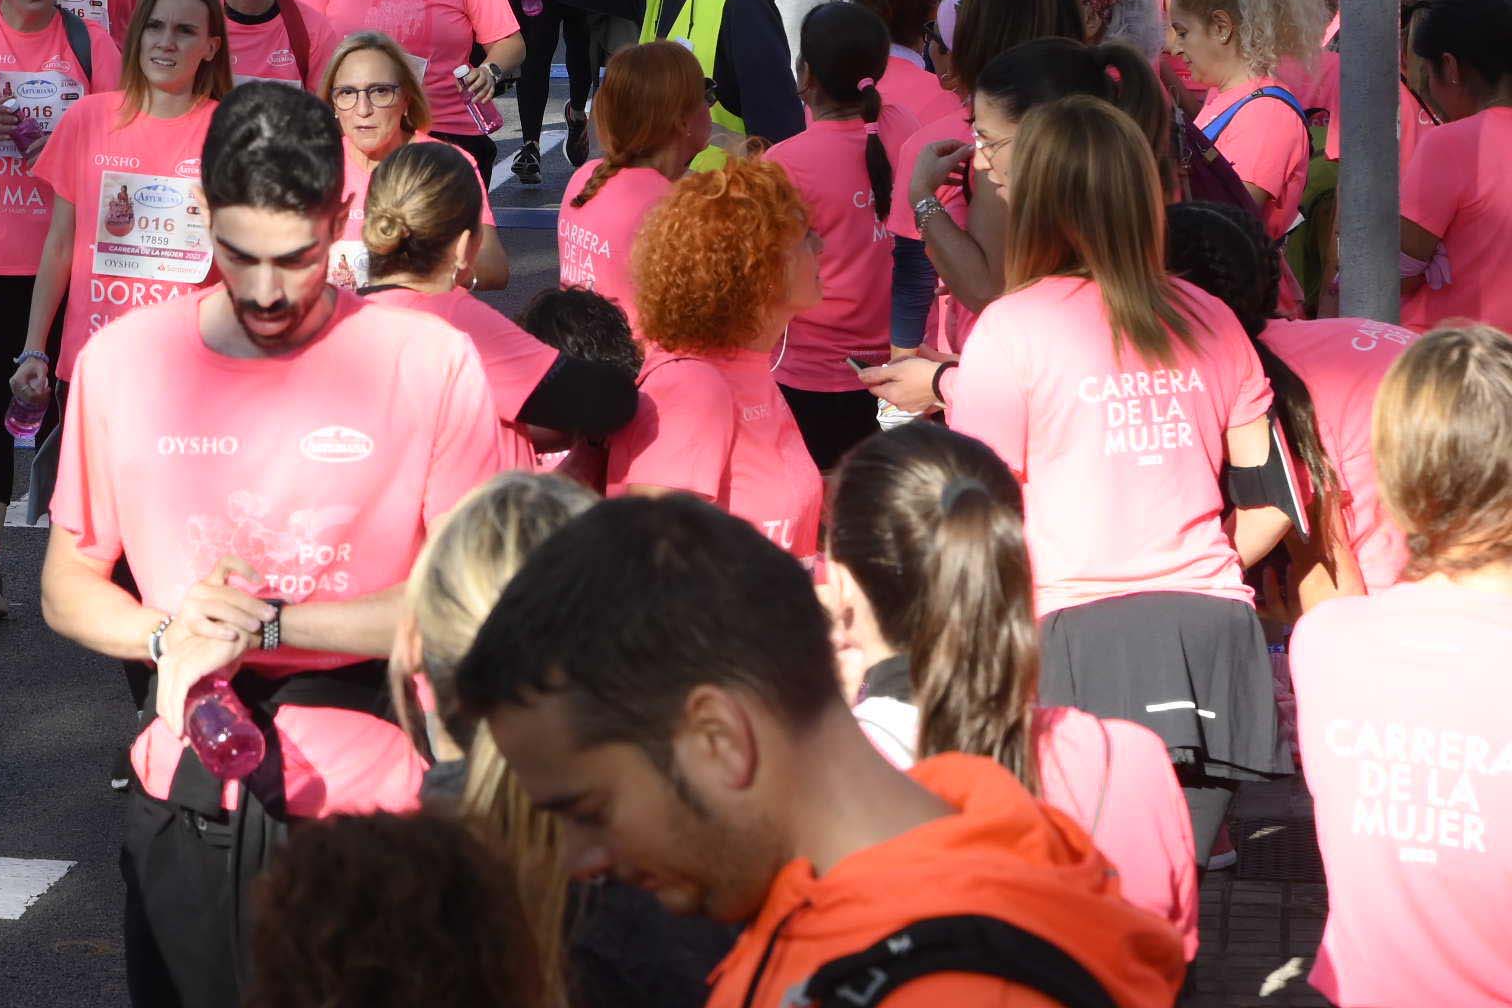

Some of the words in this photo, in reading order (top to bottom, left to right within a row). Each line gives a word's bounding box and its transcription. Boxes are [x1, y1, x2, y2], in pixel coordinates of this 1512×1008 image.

[94, 154, 140, 169] OYSHO
[138, 216, 175, 232] 016
[559, 218, 611, 259] CARRERA
[108, 245, 140, 254] CARRERA
[140, 235, 169, 246] 17859
[104, 259, 139, 269] OYSHO
[565, 241, 577, 263] DE
[579, 249, 594, 273] LA
[560, 262, 596, 292] MUJER
[1078, 367, 1205, 400] CARRERA
[1107, 401, 1144, 427] DE
[1150, 395, 1188, 423] LA
[157, 435, 239, 456] OYSHO
[1104, 421, 1194, 456] MUJER
[297, 542, 353, 566] POR
[264, 572, 350, 594] TODAS
[1325, 719, 1512, 776] CARRERA
[1359, 759, 1413, 801] DE
[1427, 767, 1481, 813] LA
[1351, 797, 1486, 853] MUJER
